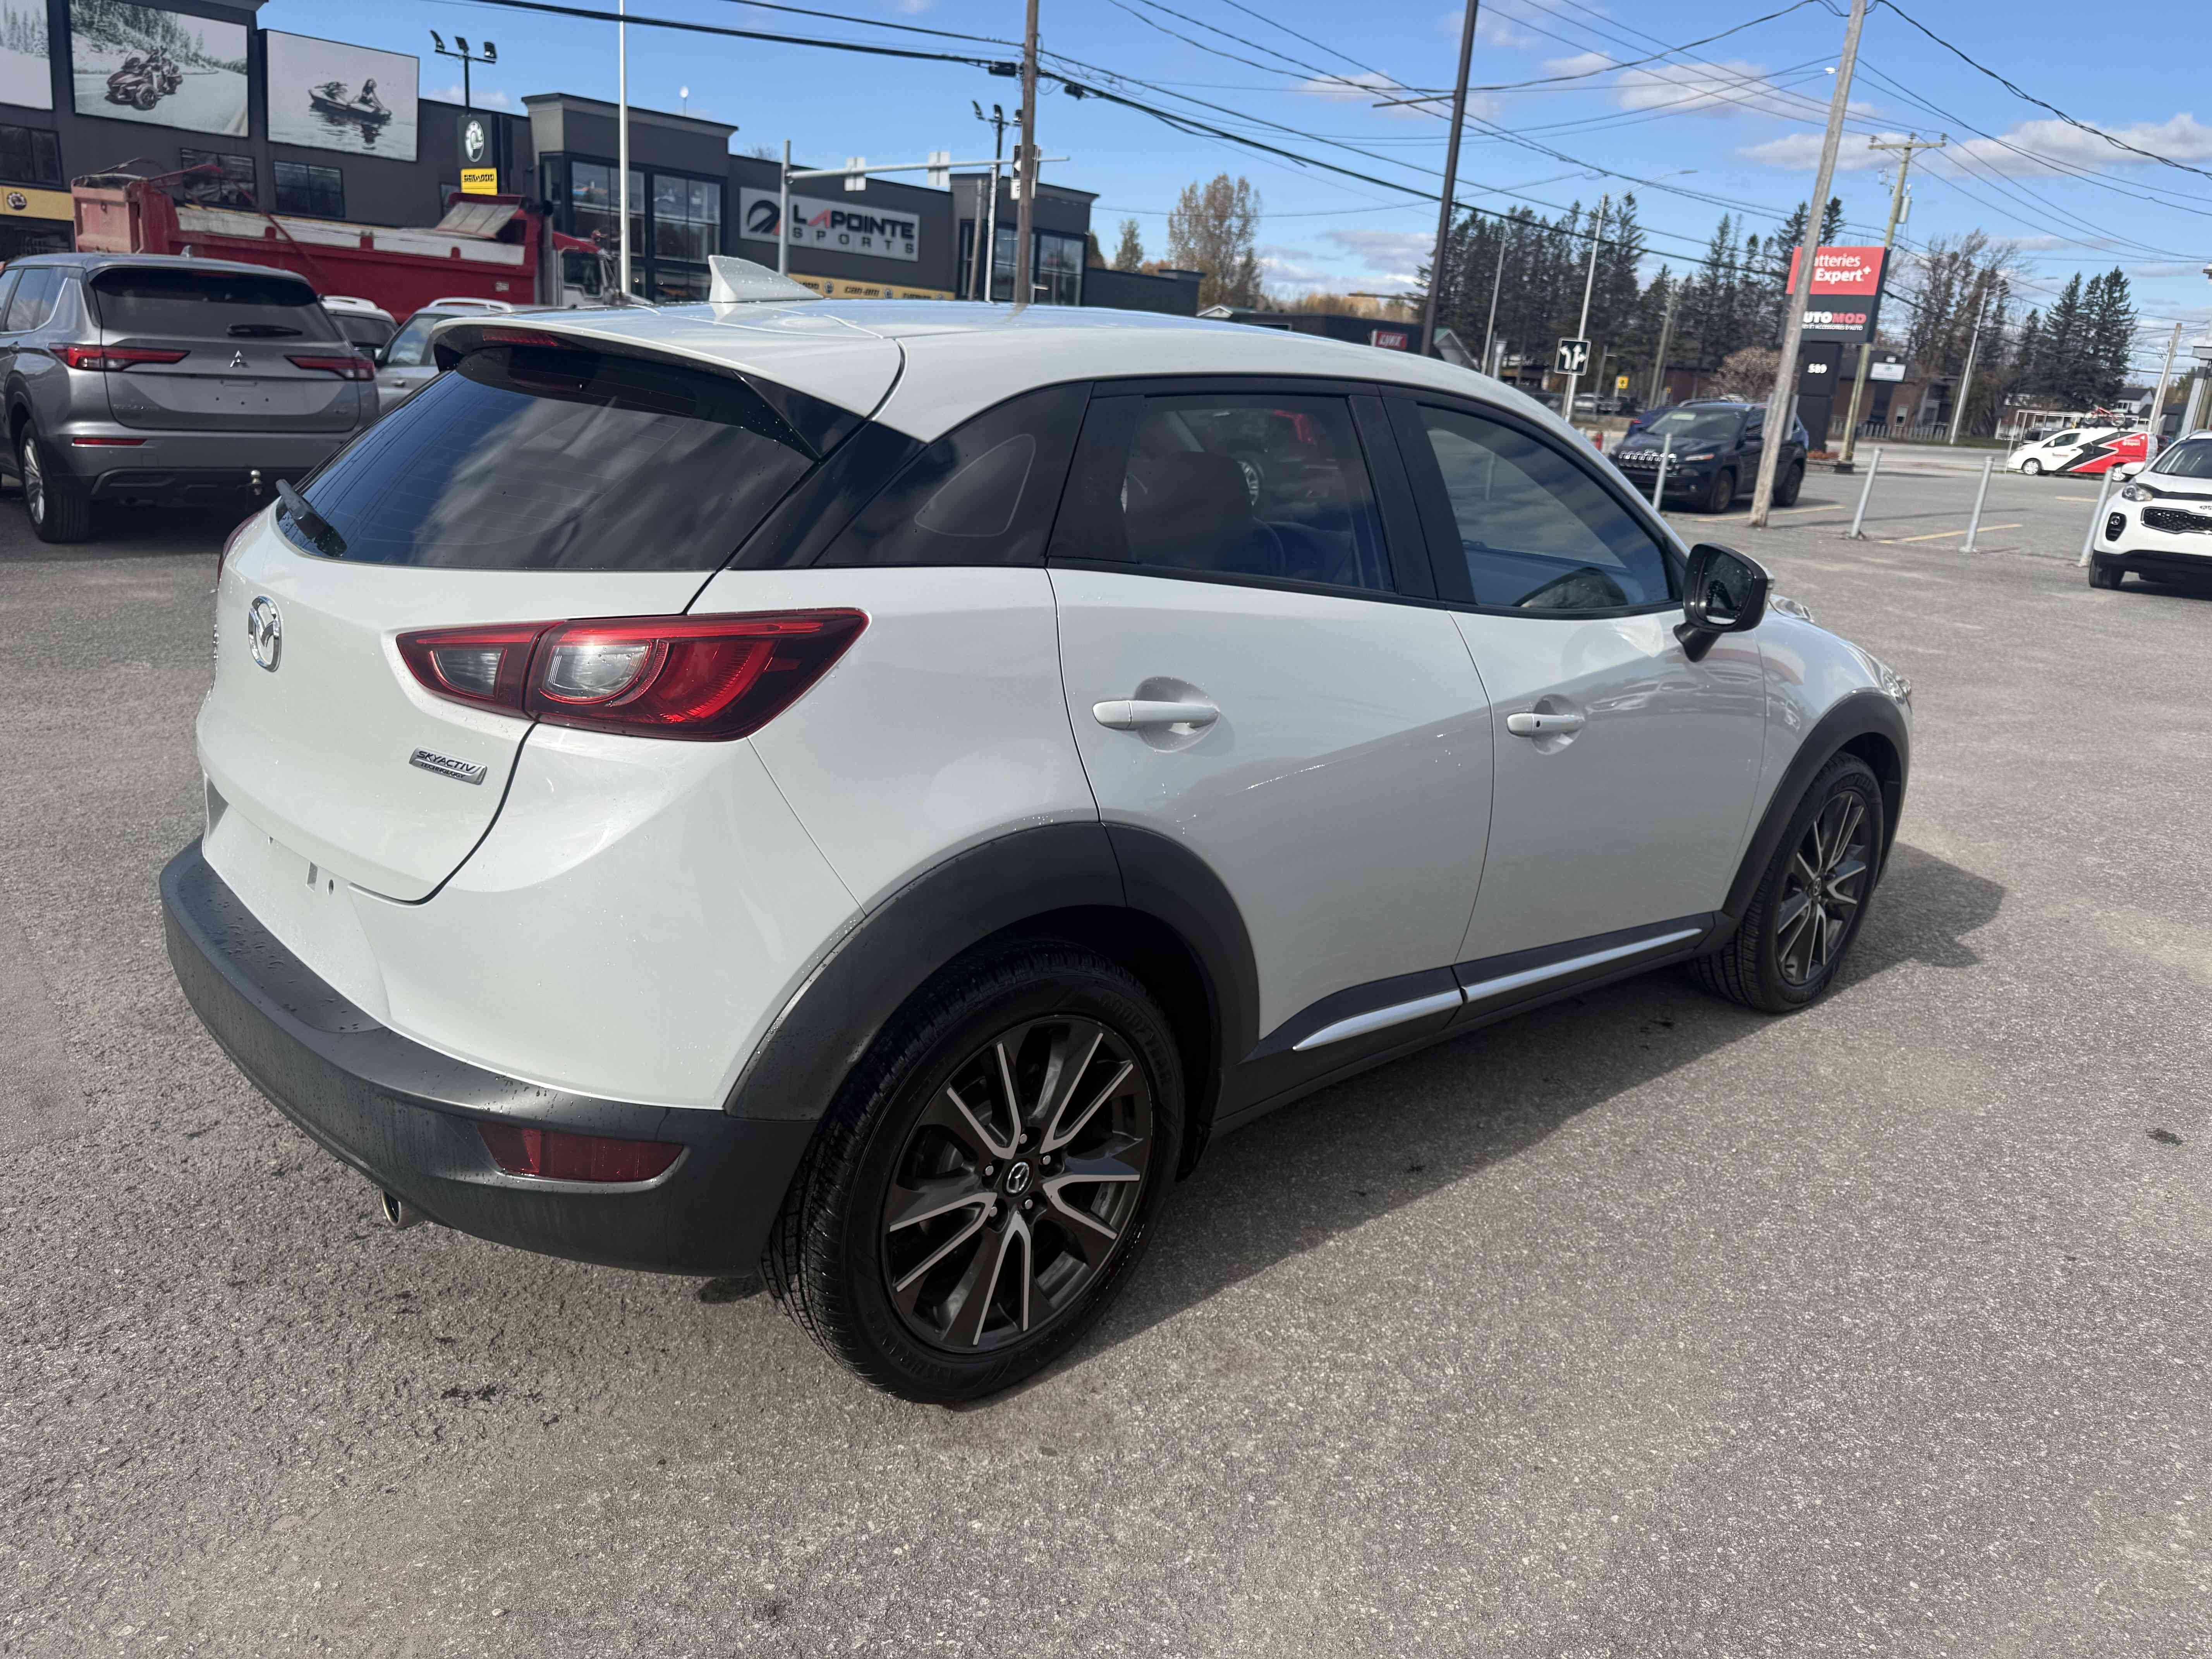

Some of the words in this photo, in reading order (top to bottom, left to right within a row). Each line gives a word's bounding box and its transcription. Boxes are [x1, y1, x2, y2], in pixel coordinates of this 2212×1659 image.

[793, 204, 915, 239] LAPOINTE
[793, 228, 914, 254] SPORTS
[1814, 253, 1861, 267] atteries
[1815, 268, 1863, 285] Expert
[1803, 311, 1867, 324] UTOMOD
[417, 750, 476, 772] SKYACTIV
[421, 762, 466, 778] TECHNOLOGY
